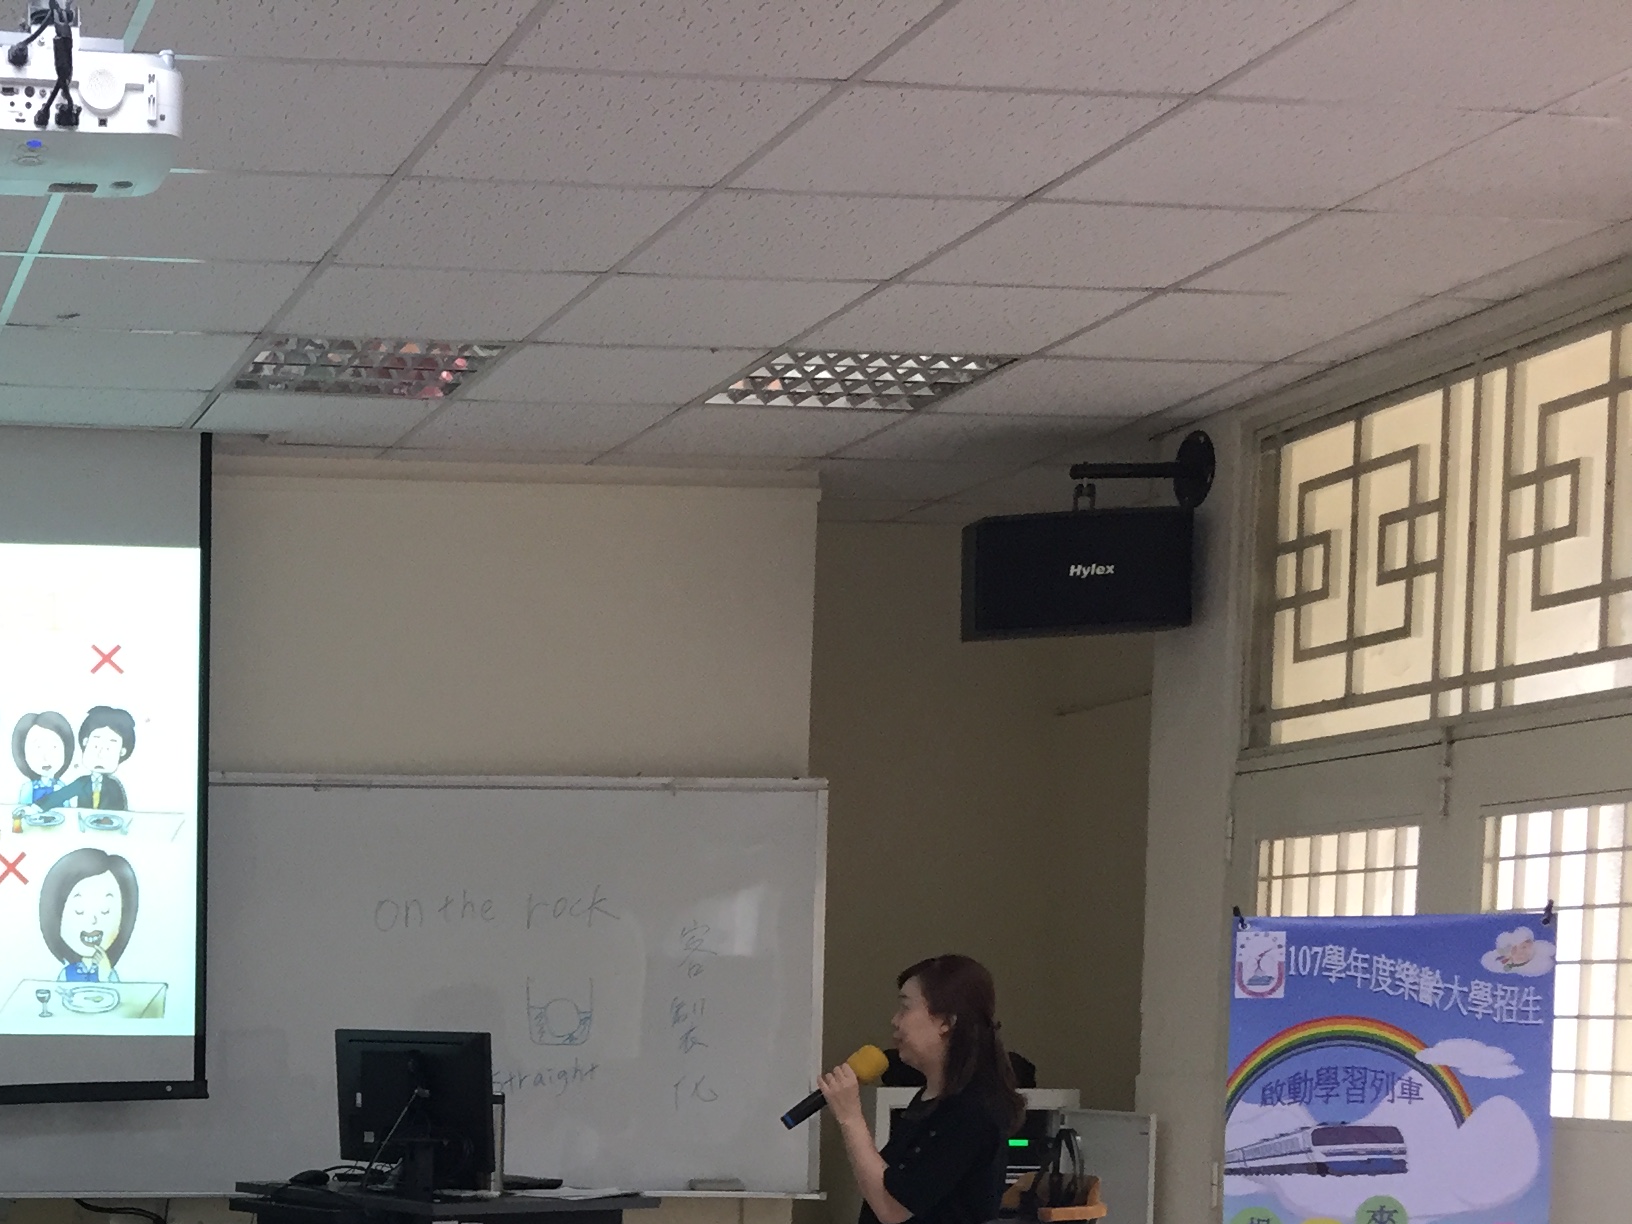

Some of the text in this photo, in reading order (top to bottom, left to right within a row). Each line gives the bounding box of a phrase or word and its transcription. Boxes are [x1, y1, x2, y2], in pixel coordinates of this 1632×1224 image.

[1068, 563, 1115, 579] Hylex
[437, 888, 495, 924] the
[526, 884, 622, 929] rock
[1287, 944, 1544, 1026] 107學年度樂齡大學招生
